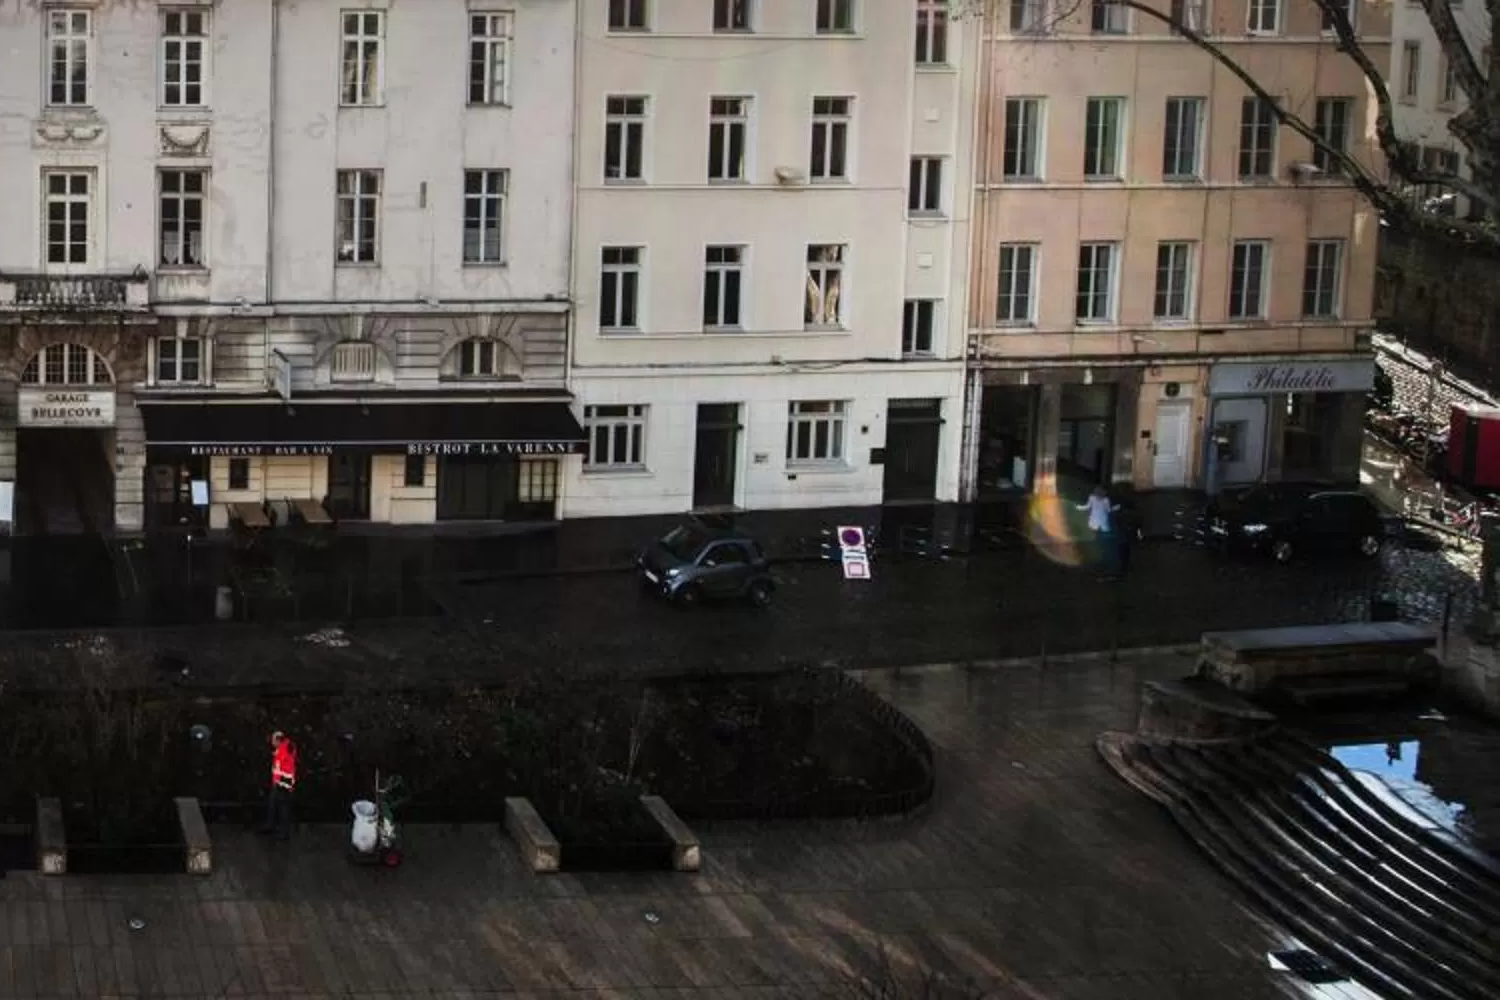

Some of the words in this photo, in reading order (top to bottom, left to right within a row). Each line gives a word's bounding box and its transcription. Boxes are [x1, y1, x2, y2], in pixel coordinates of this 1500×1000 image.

[1246, 367, 1336, 389] Philatélie
[45, 393, 89, 402] GARAGE
[407, 442, 471, 455] BISTROT
[481, 442, 499, 454] LA
[507, 442, 574, 453] VARENNE
